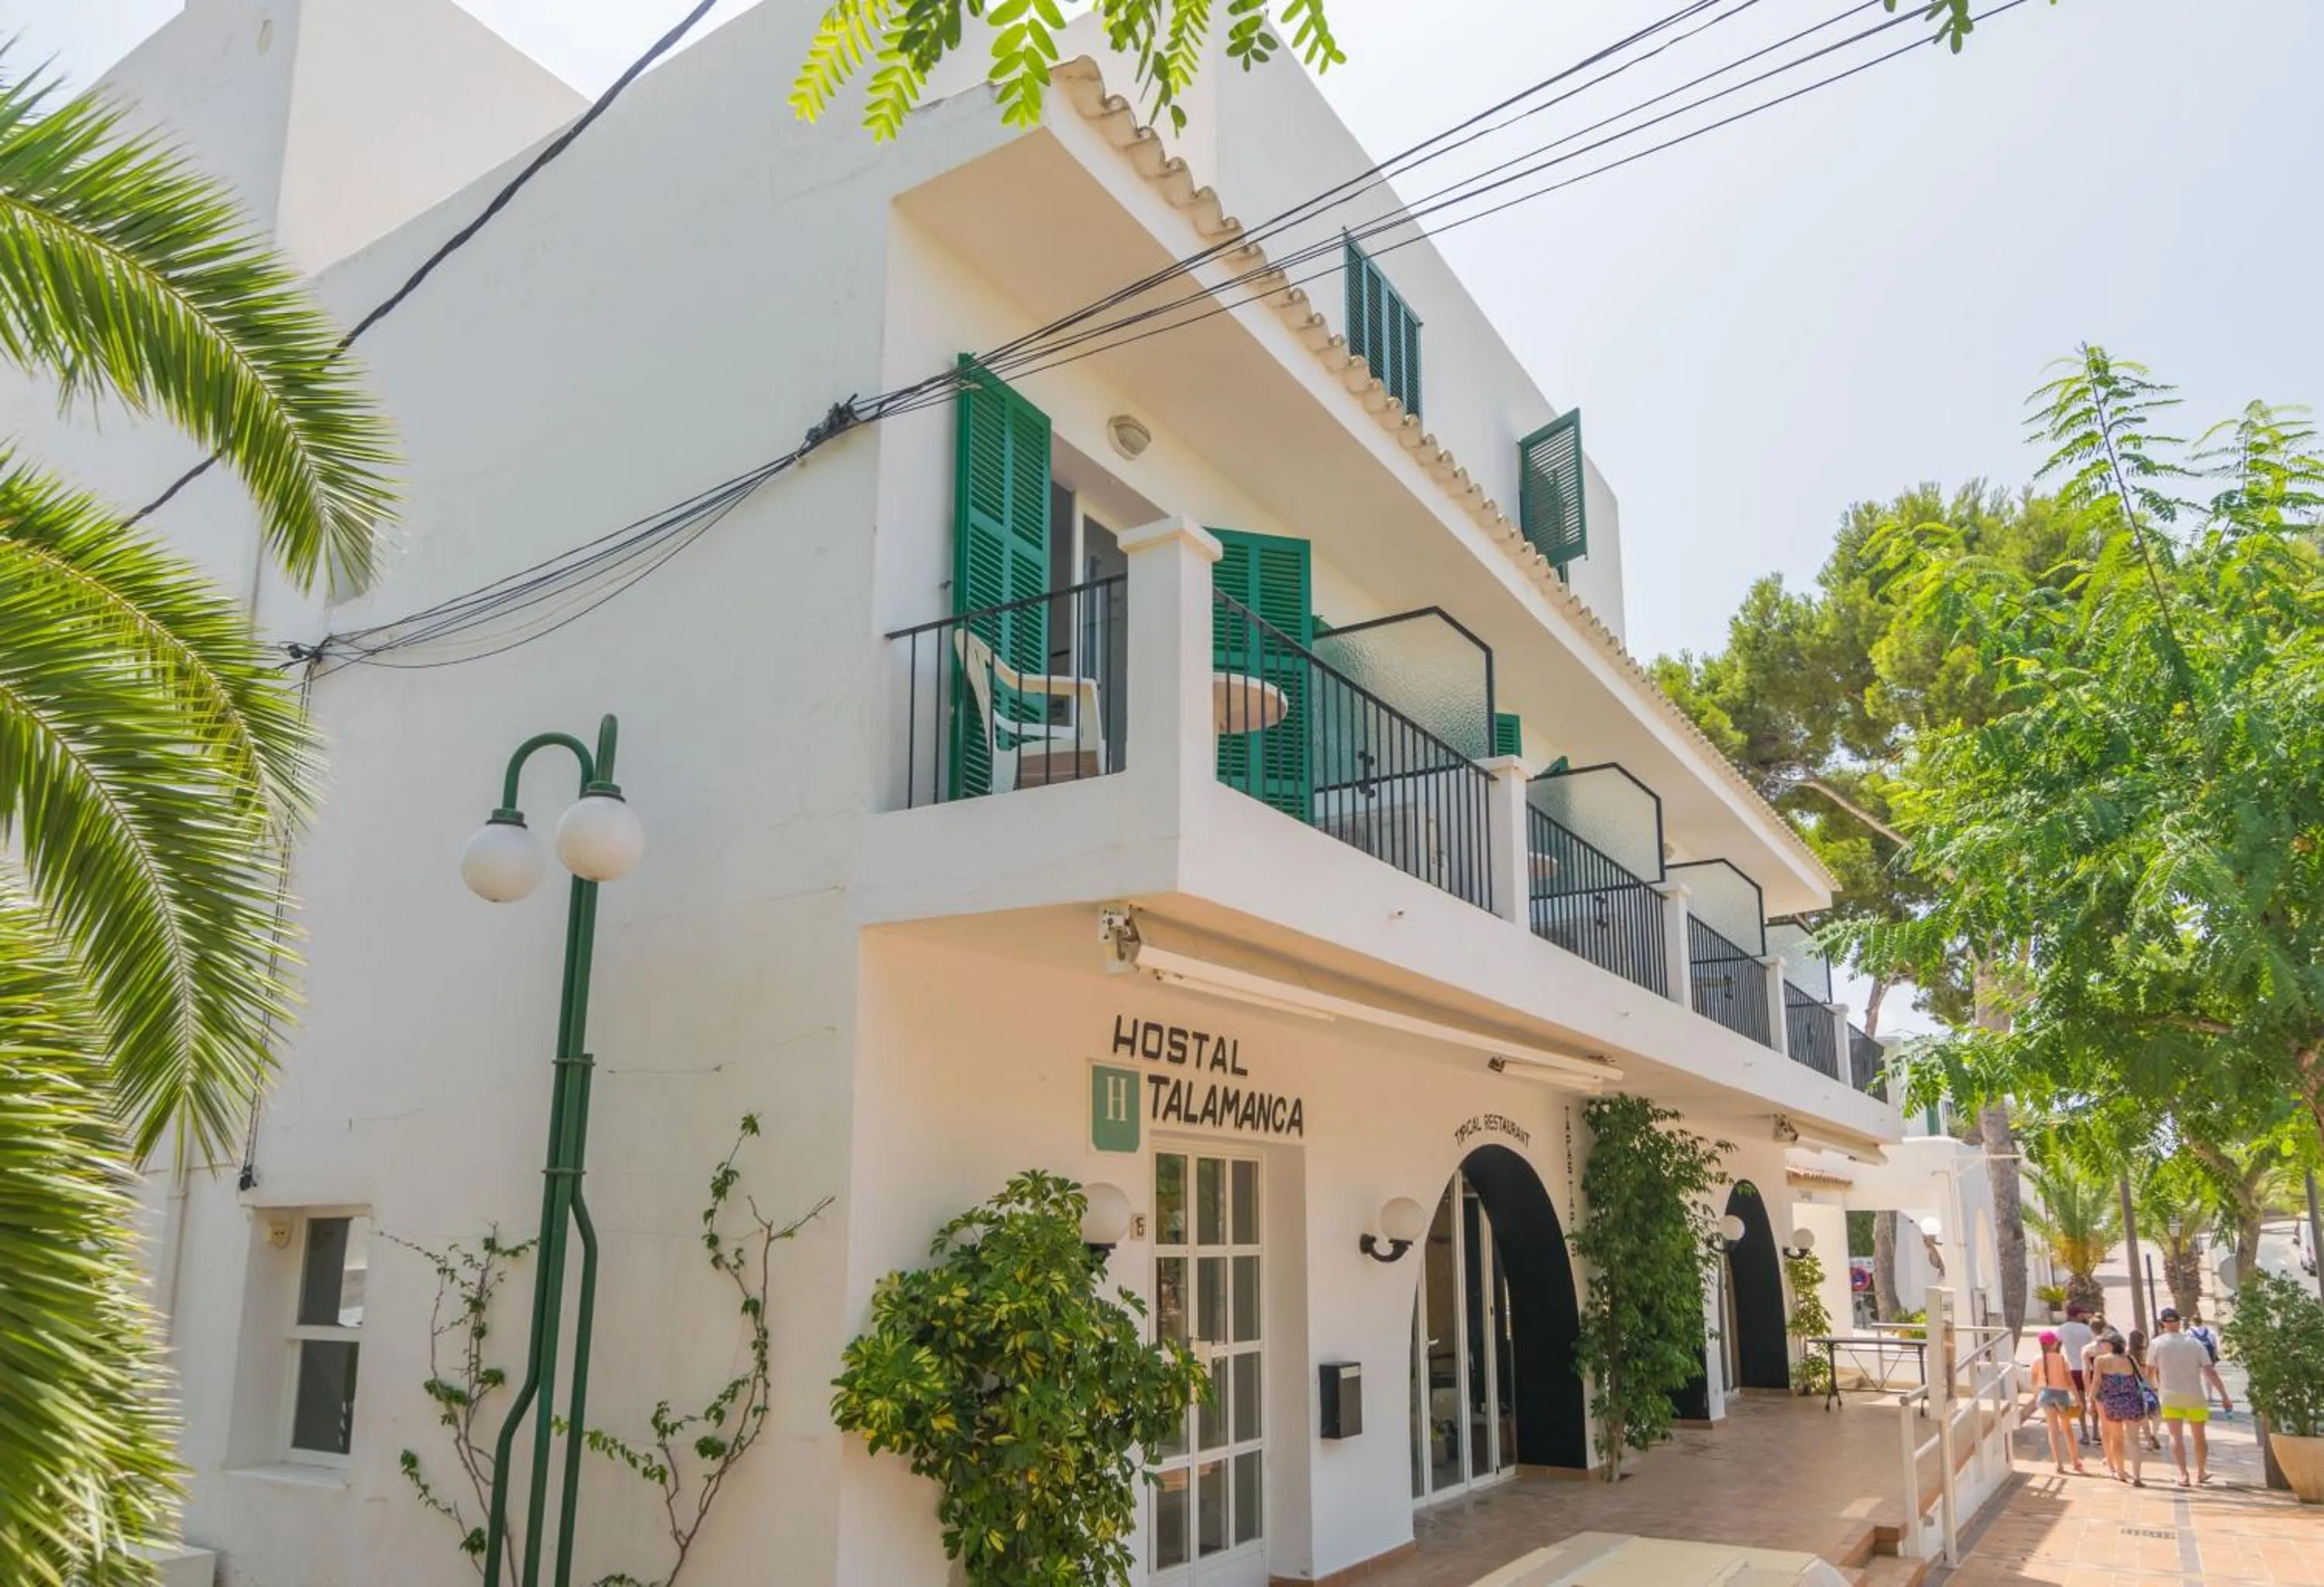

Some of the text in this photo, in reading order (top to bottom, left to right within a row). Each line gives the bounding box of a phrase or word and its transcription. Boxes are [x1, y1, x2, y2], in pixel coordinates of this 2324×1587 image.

[1113, 1014, 1248, 1076] HOSTAL
[1106, 1076, 1129, 1122] H
[1147, 1074, 1304, 1138] TALAMANCA
[1483, 1114, 1531, 1148] RESTAURANT
